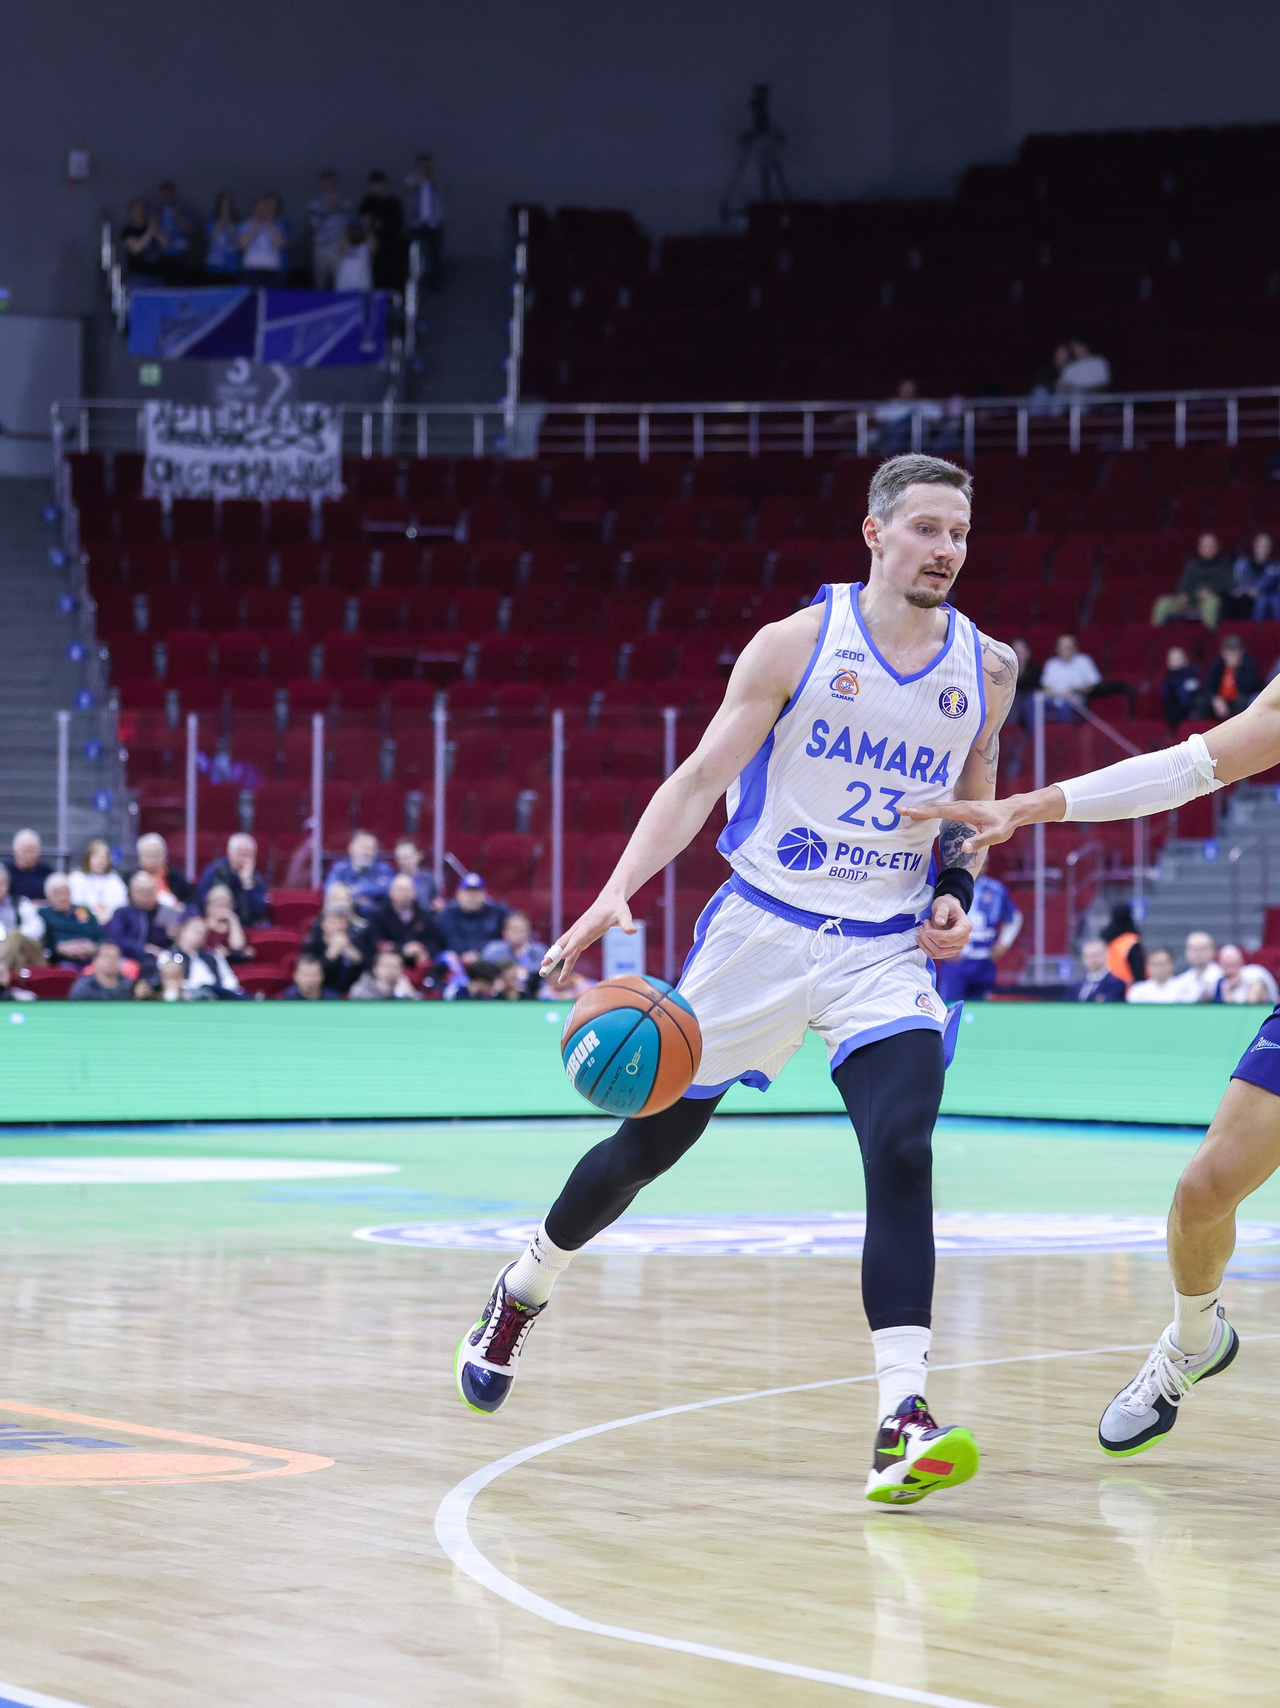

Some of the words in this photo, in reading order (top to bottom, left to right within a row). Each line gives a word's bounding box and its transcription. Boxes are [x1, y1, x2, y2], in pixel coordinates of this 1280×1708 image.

[834, 648, 866, 663] ZEDO
[805, 718, 952, 788] SAMARA
[837, 780, 906, 832] 23
[828, 865, 869, 881] ВОЛГА
